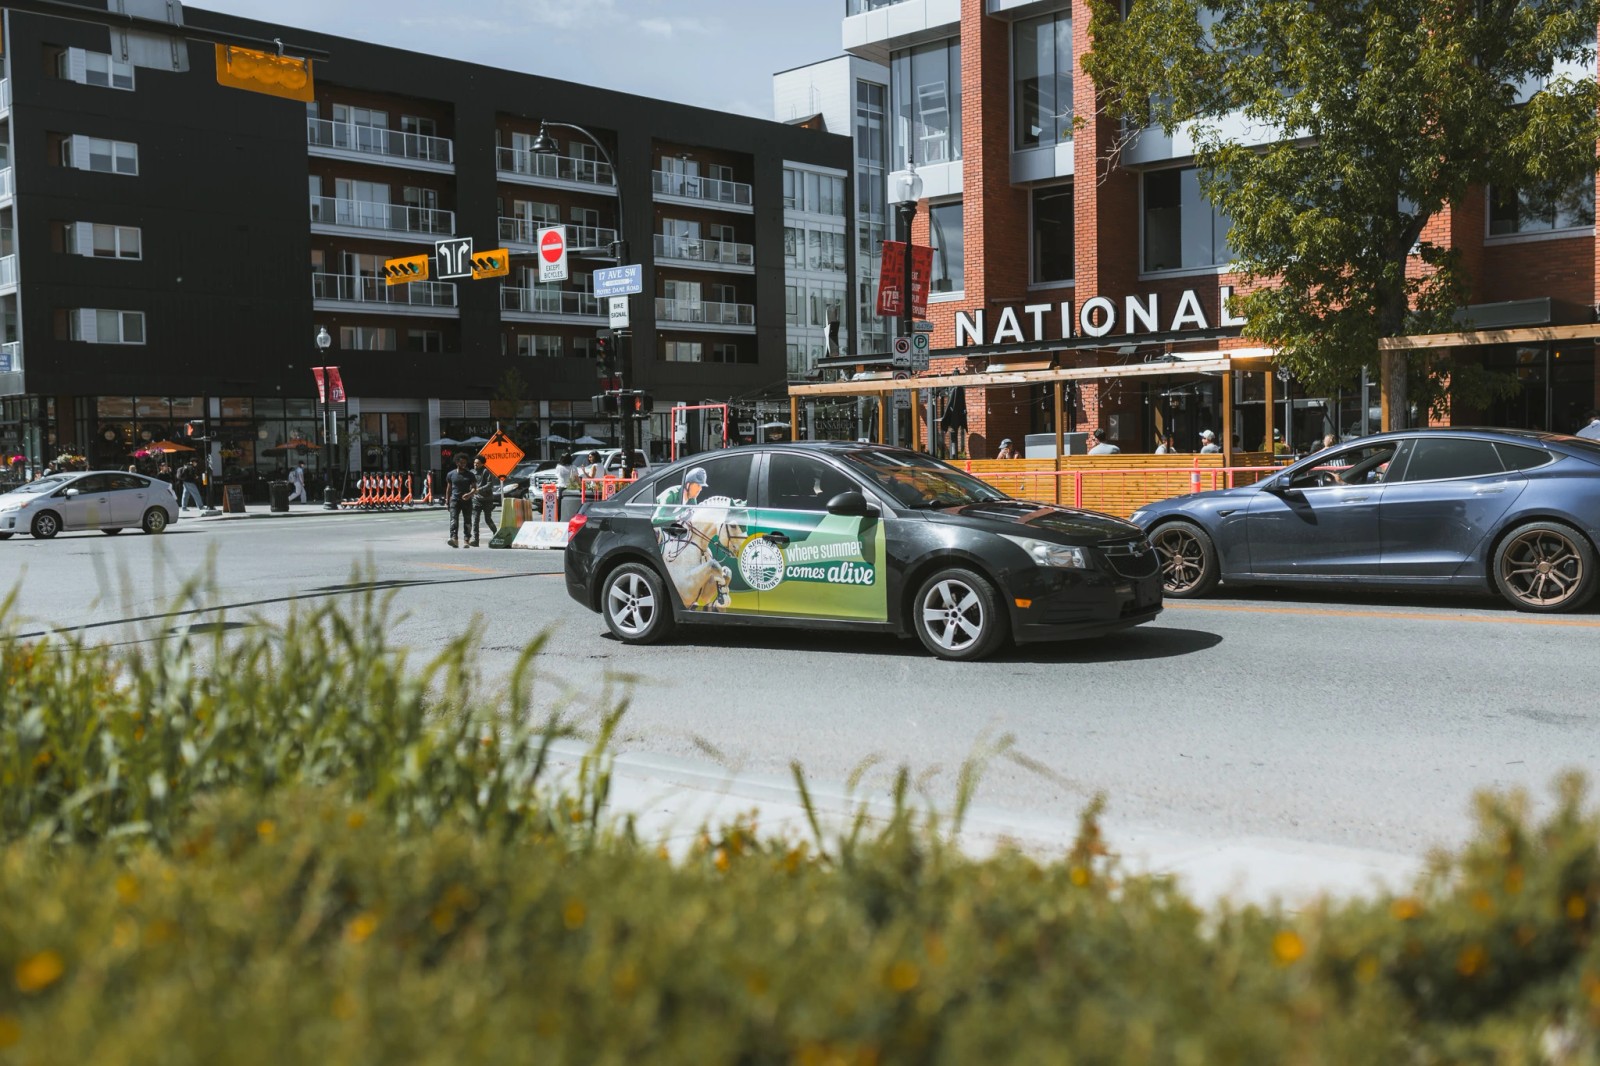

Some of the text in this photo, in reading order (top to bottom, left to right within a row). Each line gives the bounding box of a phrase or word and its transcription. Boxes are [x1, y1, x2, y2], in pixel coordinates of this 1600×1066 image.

[598, 267, 636, 280] 17 AVE SW
[612, 286, 625, 294] DAME
[626, 284, 640, 292] ROAD
[882, 290, 892, 307] 17
[955, 286, 1248, 347] NATIONAL
[484, 452, 521, 460] ONSTRUCTION
[786, 540, 863, 562] where summer
[786, 561, 874, 585] comes alive
